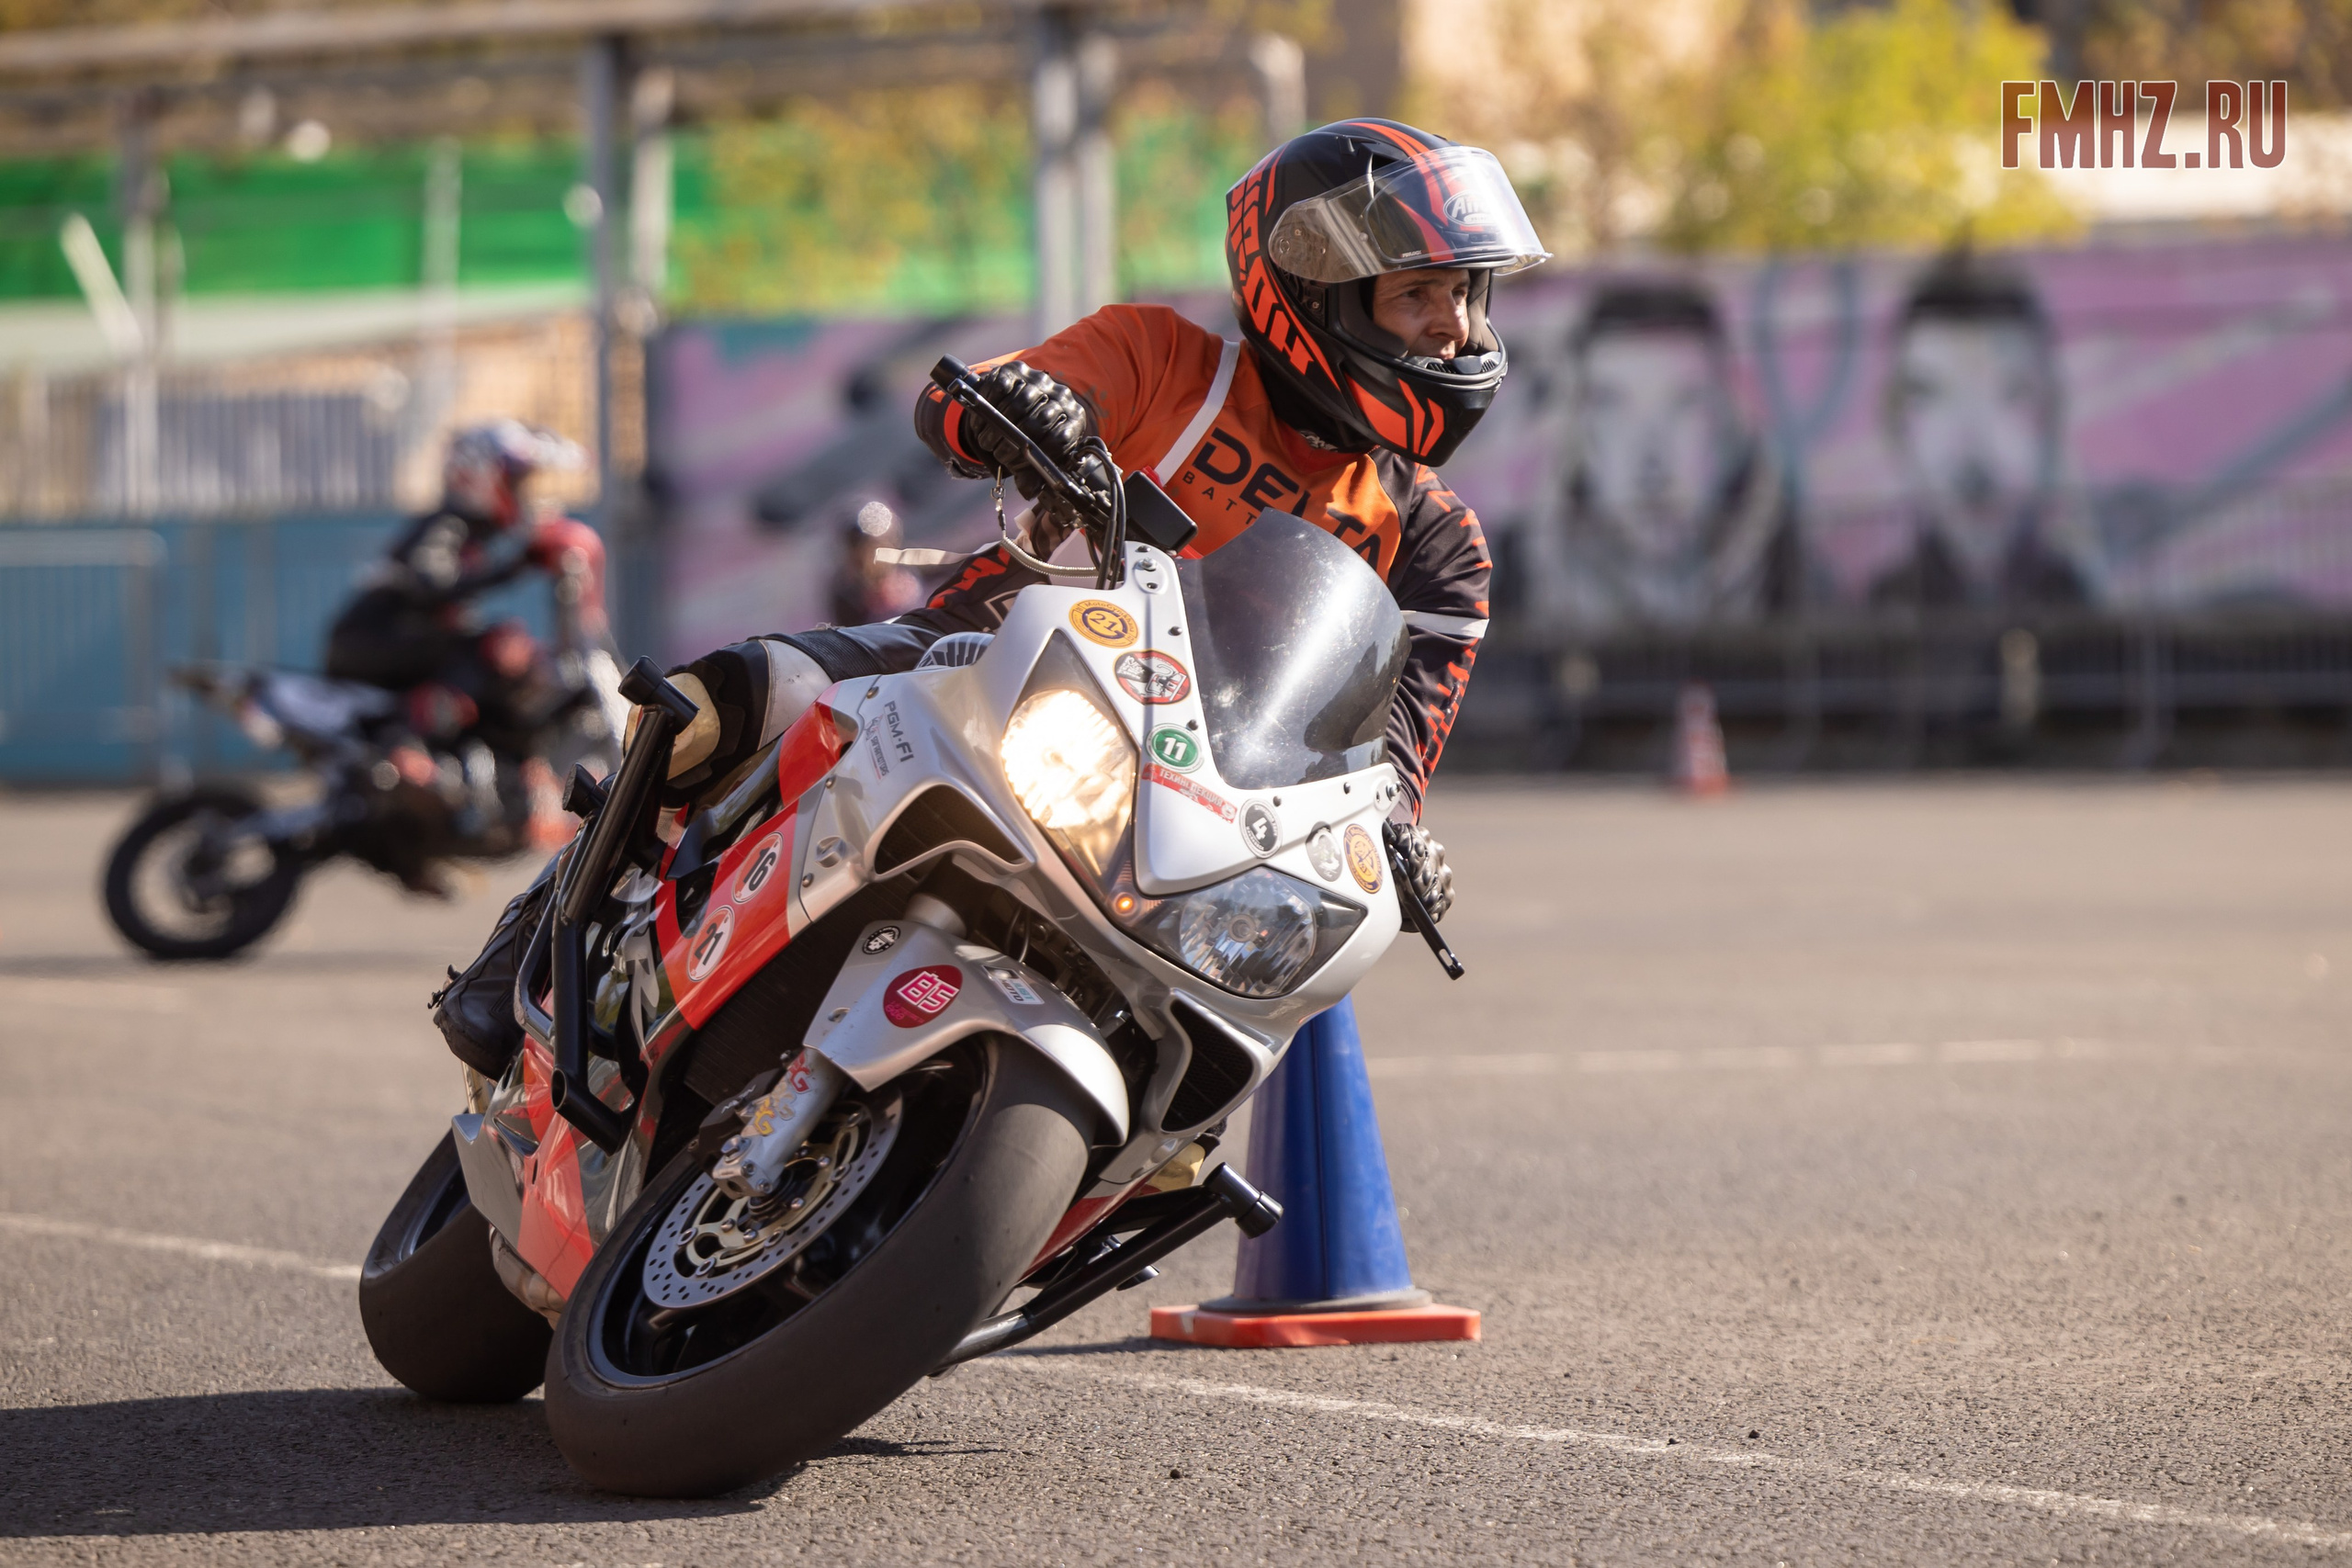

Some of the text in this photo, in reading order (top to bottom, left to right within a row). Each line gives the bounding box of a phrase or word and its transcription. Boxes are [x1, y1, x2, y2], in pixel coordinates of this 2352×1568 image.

[1090, 613, 1118, 631] 21
[1164, 737, 1187, 761] 11
[743, 847, 776, 891] 16
[695, 922, 723, 965] 21
